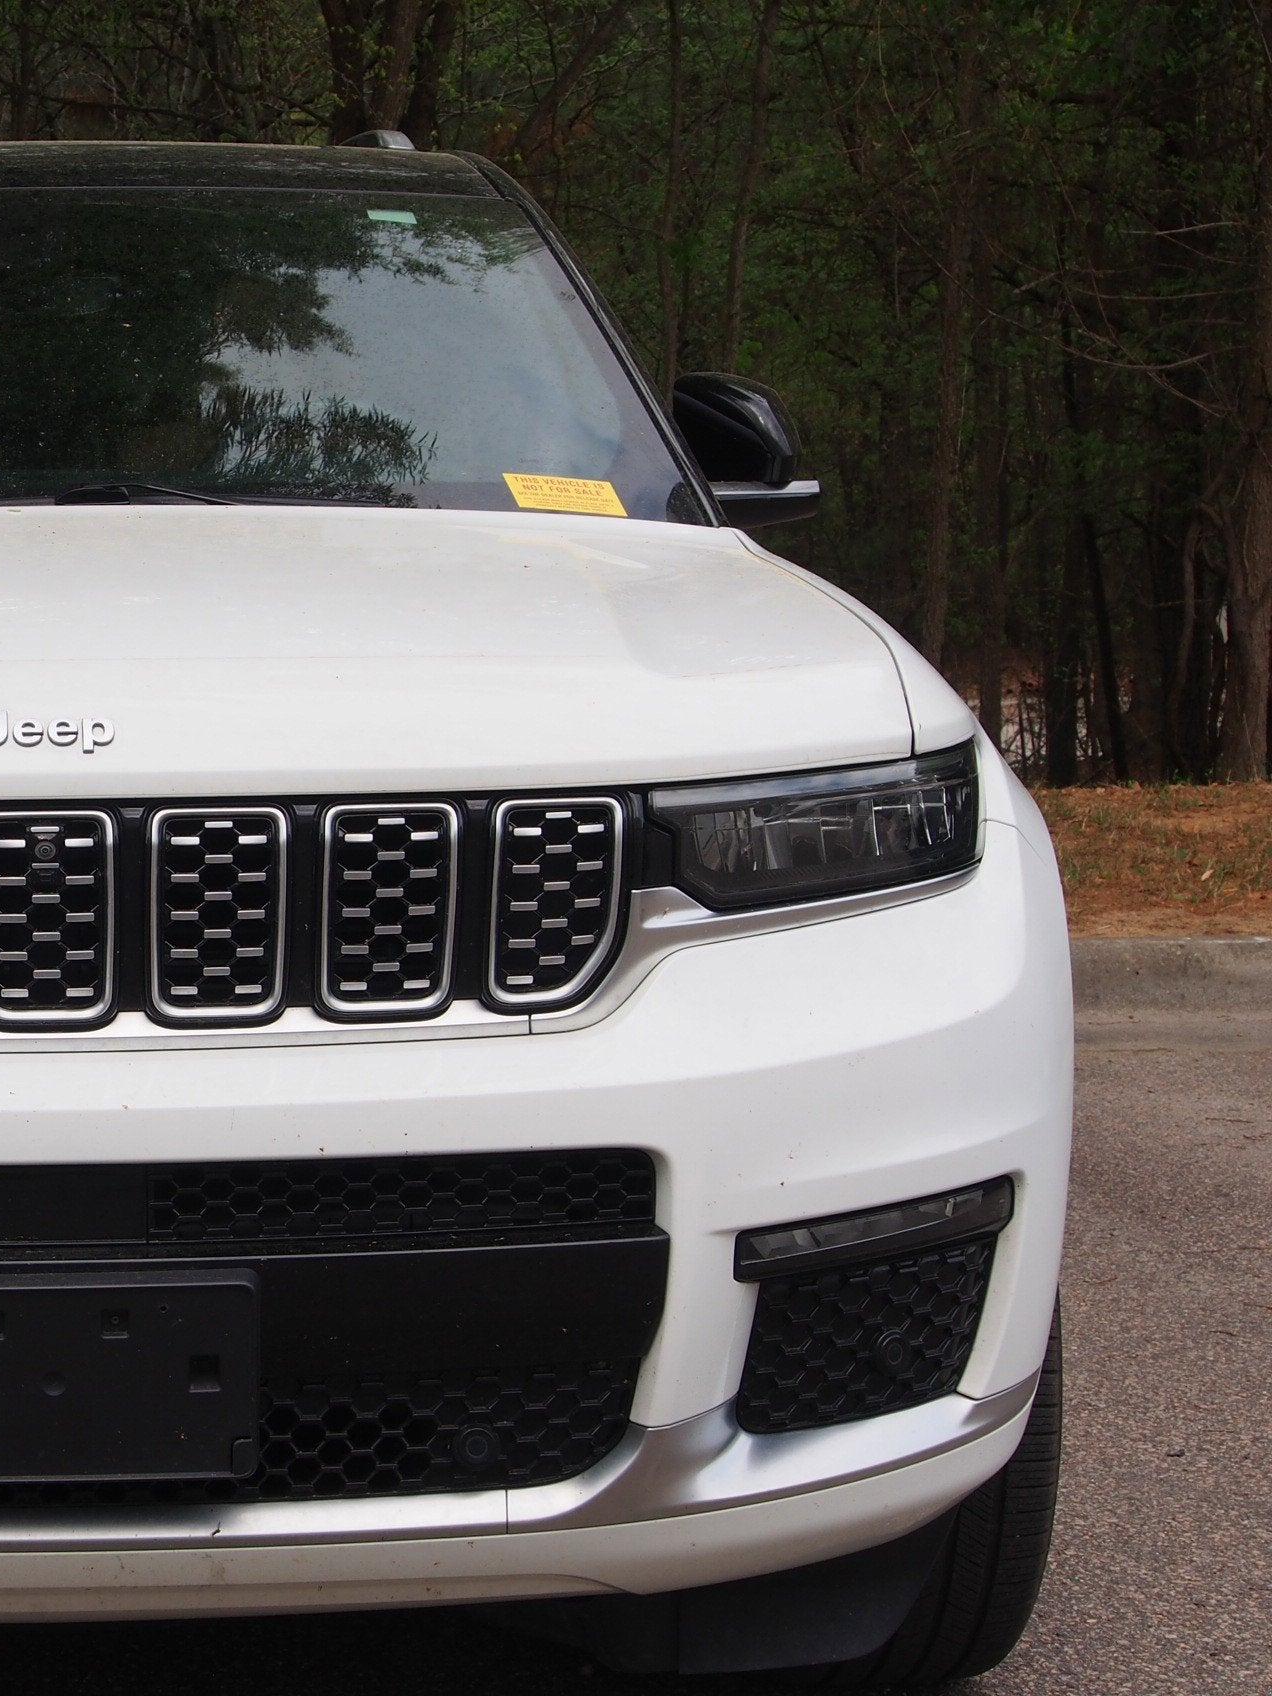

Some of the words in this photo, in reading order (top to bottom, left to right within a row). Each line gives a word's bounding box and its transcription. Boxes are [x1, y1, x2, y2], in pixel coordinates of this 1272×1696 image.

[513, 476, 540, 484] THIS
[542, 478, 591, 488] VEHICLE
[593, 482, 605, 490] IS
[548, 486, 571, 494] FOR
[574, 488, 603, 497] SALE
